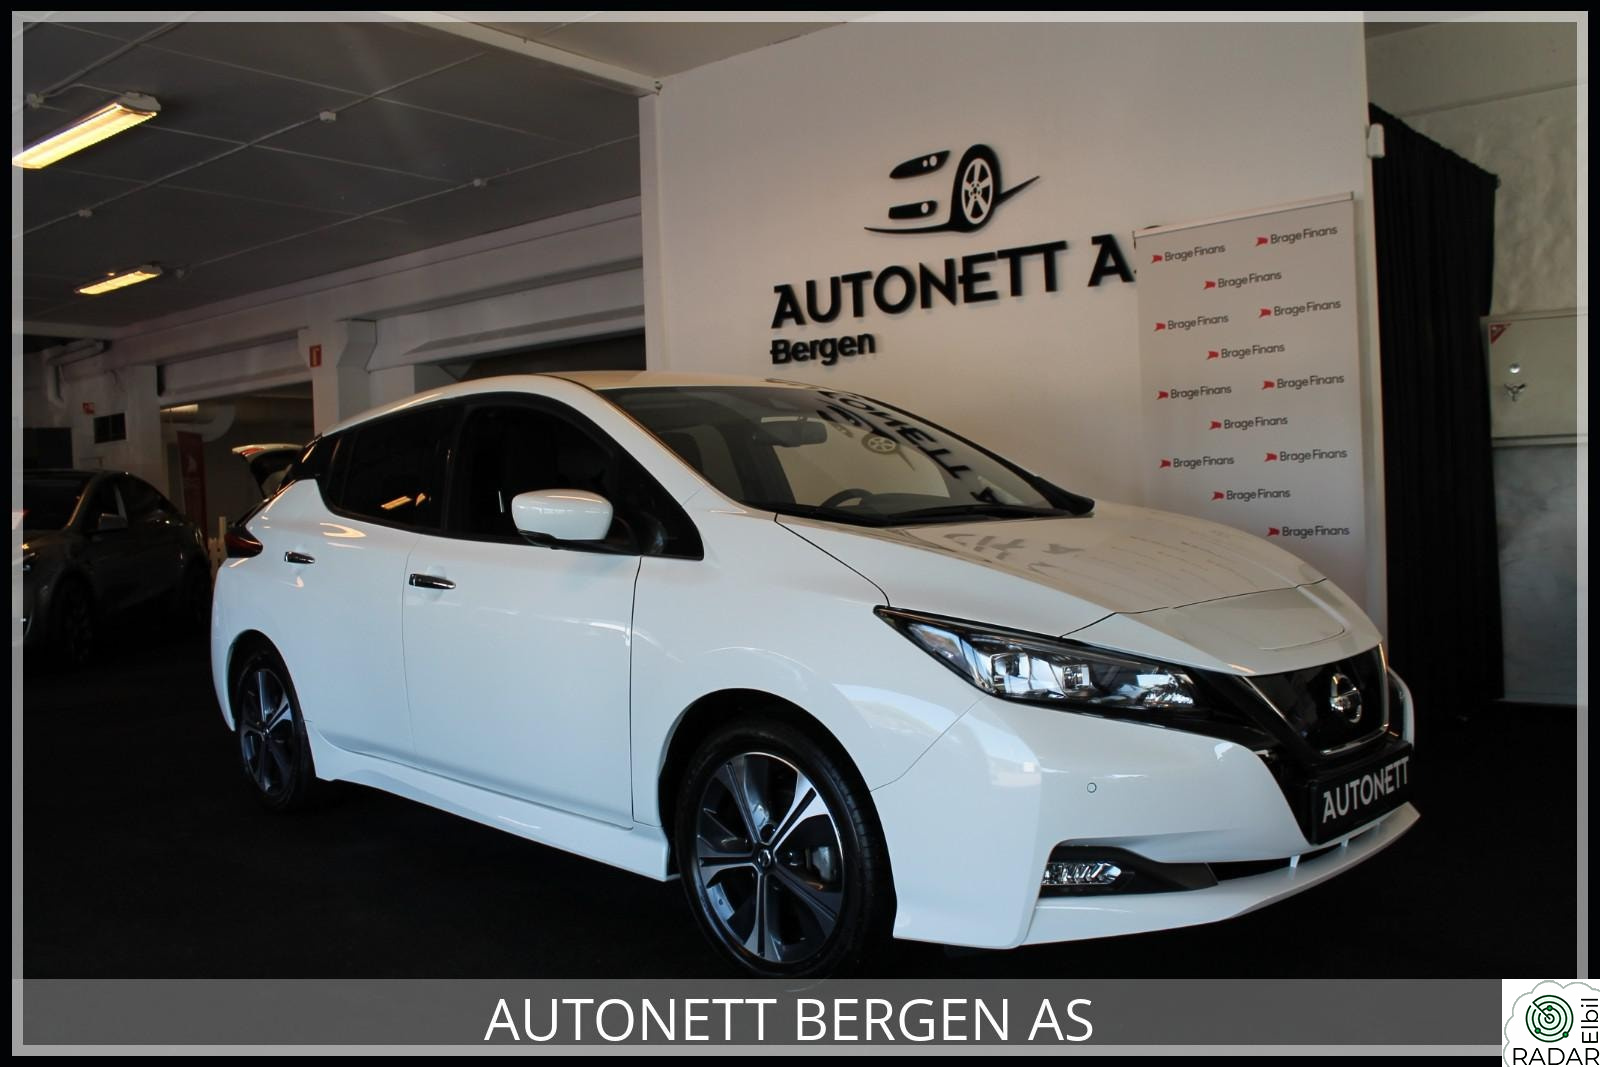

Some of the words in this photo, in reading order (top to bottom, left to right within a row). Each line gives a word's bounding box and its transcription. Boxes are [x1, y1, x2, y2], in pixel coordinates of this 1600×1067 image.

[1270, 233, 1301, 246] Brage
[1303, 226, 1337, 238] Finans
[1165, 250, 1193, 262] Brage
[1195, 245, 1225, 255] Finans
[771, 240, 1067, 328] AUTONETT
[1087, 229, 1136, 287] A
[1218, 277, 1247, 288] Brage
[1249, 271, 1281, 282] Finans
[1274, 305, 1305, 318] Brage
[1307, 300, 1341, 311] Finans
[1168, 320, 1195, 330] Brage
[1198, 314, 1228, 324] Finans
[770, 333, 876, 366] Bergen
[1221, 348, 1250, 359] Brage
[1252, 344, 1285, 354] Finans
[1277, 378, 1308, 390] Brage
[1310, 375, 1344, 386] Finans
[1171, 388, 1198, 399] Brage
[1200, 385, 1231, 395] Finans
[1224, 420, 1254, 430] Brage
[1256, 416, 1288, 426] Finans
[1173, 458, 1201, 469] Brage
[1203, 456, 1234, 466] Finans
[1280, 451, 1311, 463] Brage
[1313, 449, 1347, 459] Finans
[1226, 491, 1256, 502] Brage
[1258, 489, 1290, 499] Finans
[1282, 527, 1313, 538] Brage
[1315, 526, 1349, 536] Finans
[1322, 756, 1410, 823] AUTONETT
